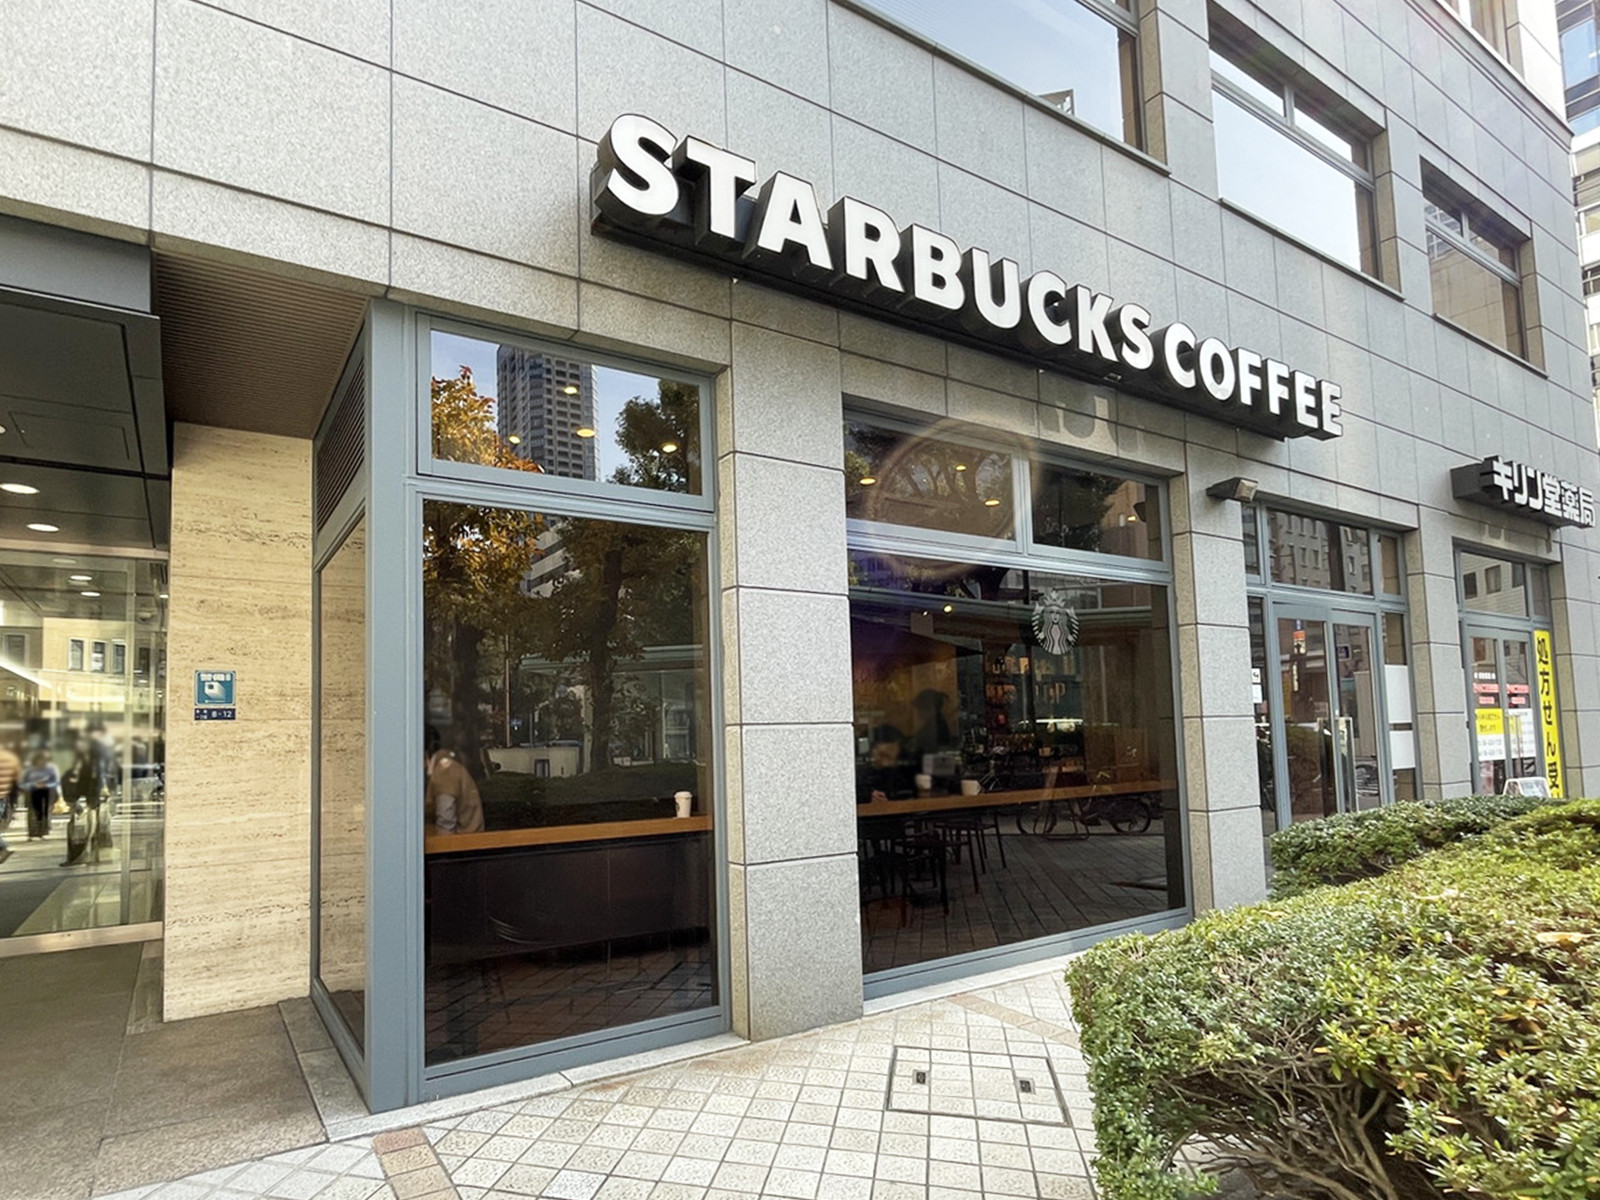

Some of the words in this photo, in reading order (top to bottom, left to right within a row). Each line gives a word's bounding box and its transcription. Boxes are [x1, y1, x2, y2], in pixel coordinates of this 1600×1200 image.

[606, 113, 1154, 371] STARBUCKS
[1164, 321, 1343, 437] COFFEE
[1491, 456, 1596, 528] キリン堂薬局
